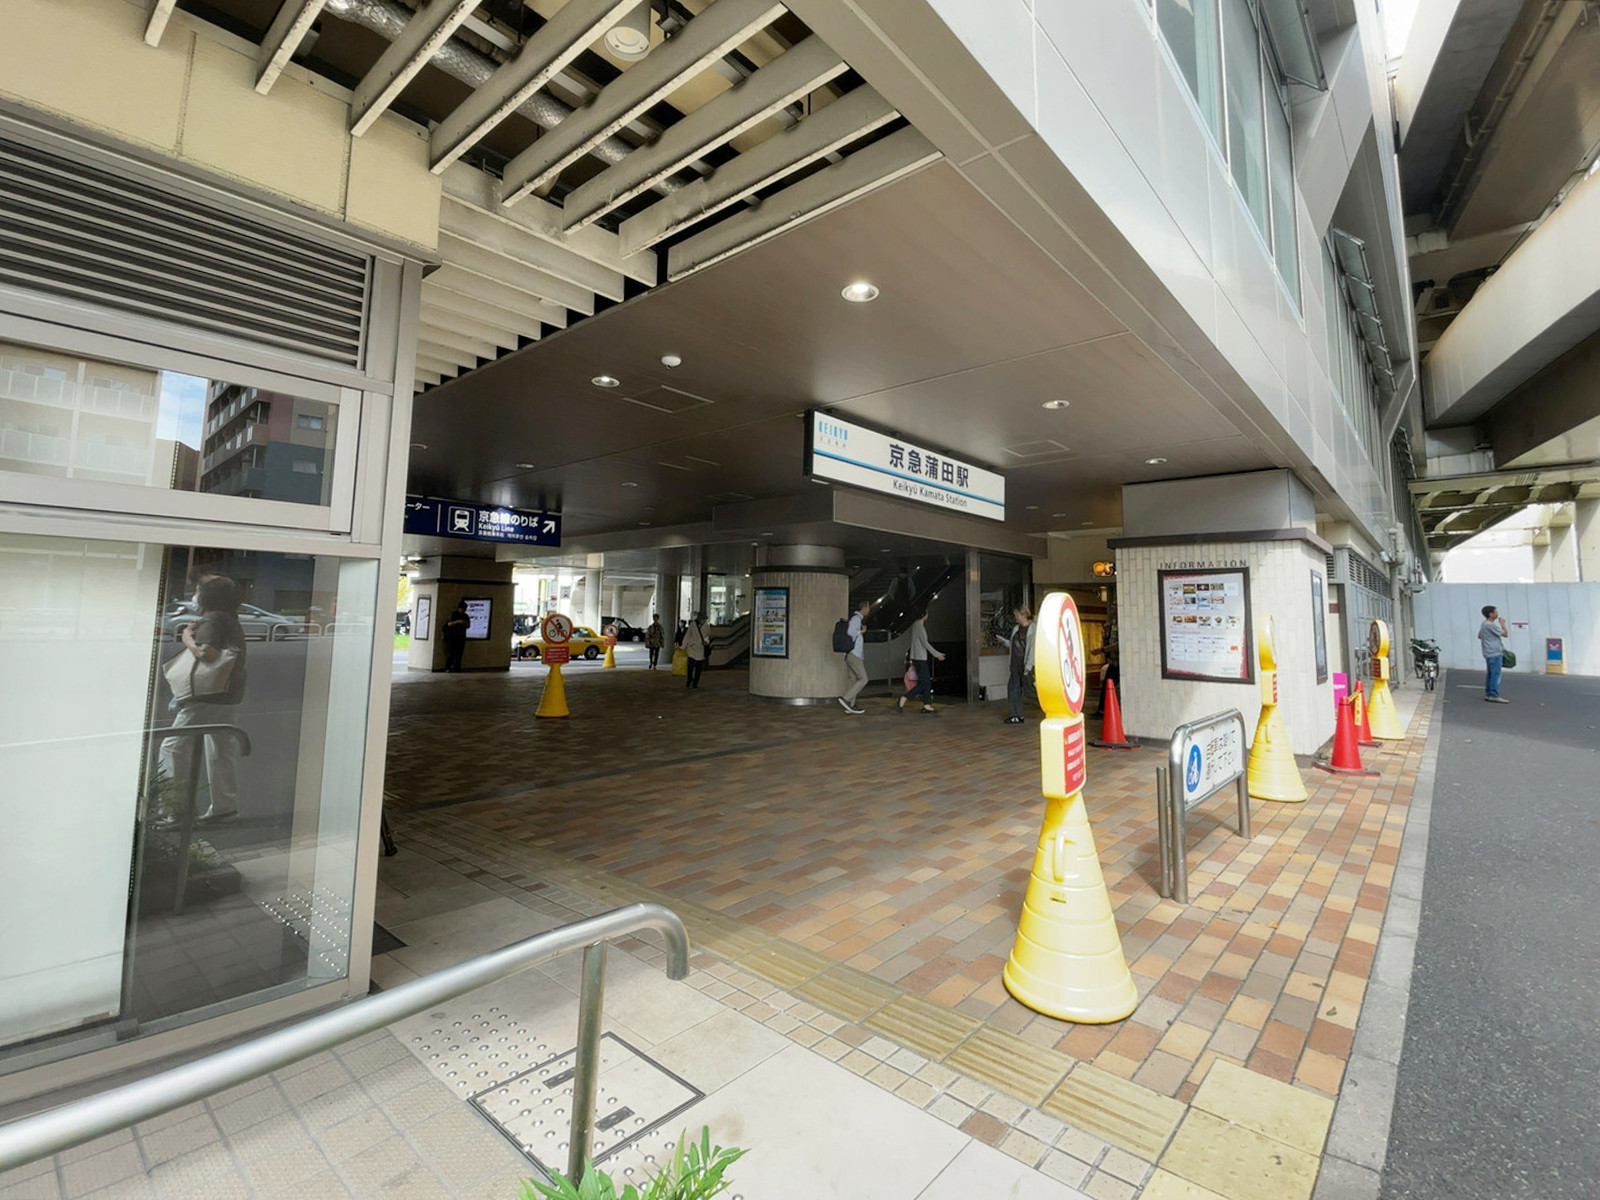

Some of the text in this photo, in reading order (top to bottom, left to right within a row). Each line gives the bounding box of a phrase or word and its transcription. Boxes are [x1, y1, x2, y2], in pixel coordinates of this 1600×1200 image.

[819, 421, 849, 440] KEIKYU
[889, 443, 969, 488] 京急蒲田駅
[919, 485, 945, 501] Kamata
[945, 493, 968, 507] Station
[405, 502, 430, 511] ーター
[501, 524, 515, 533] Line
[1159, 559, 1247, 569] INFORMATION
